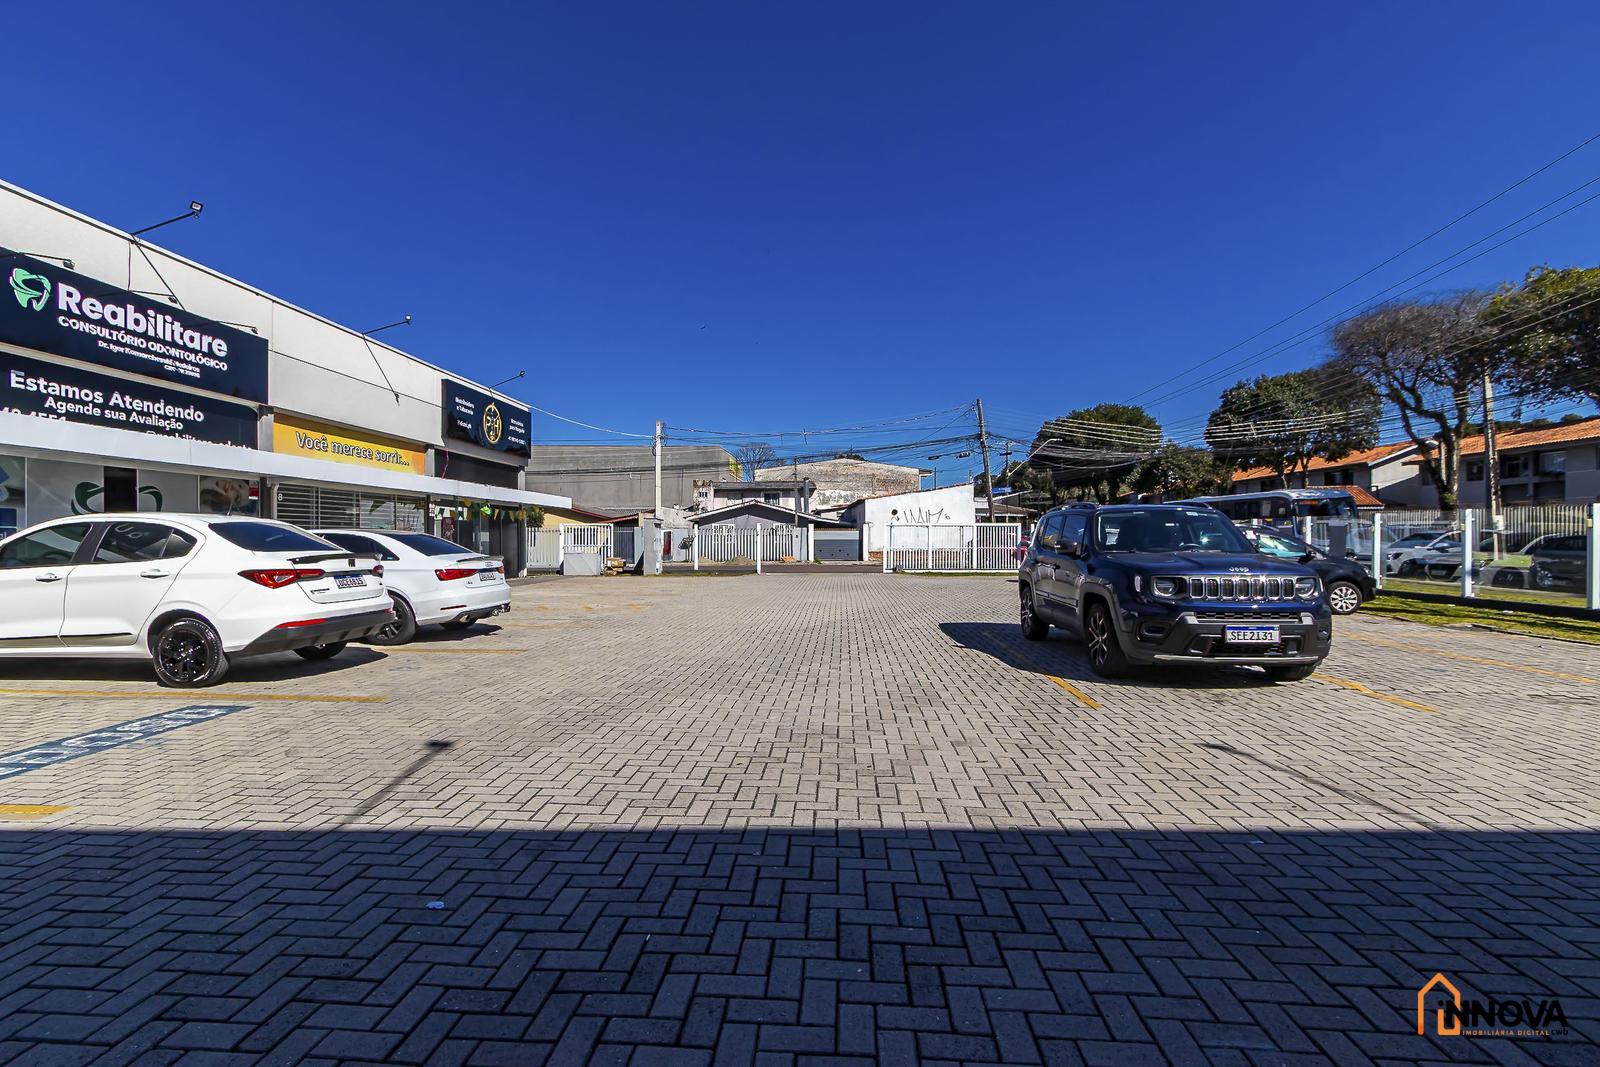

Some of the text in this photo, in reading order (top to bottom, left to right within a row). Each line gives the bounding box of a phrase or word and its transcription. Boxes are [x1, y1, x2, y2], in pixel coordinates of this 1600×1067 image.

[58, 283, 227, 356] Reabilitare
[58, 316, 228, 371] CONSULTÓRIO ODONTOLÓGICO
[98, 340, 109, 349] Dr.
[10, 370, 205, 422] Estamos Atendendo
[44, 396, 101, 416] Agende
[104, 409, 127, 421] sua
[129, 412, 183, 431] Avaliação
[296, 431, 328, 452] Você
[331, 441, 374, 460] merece
